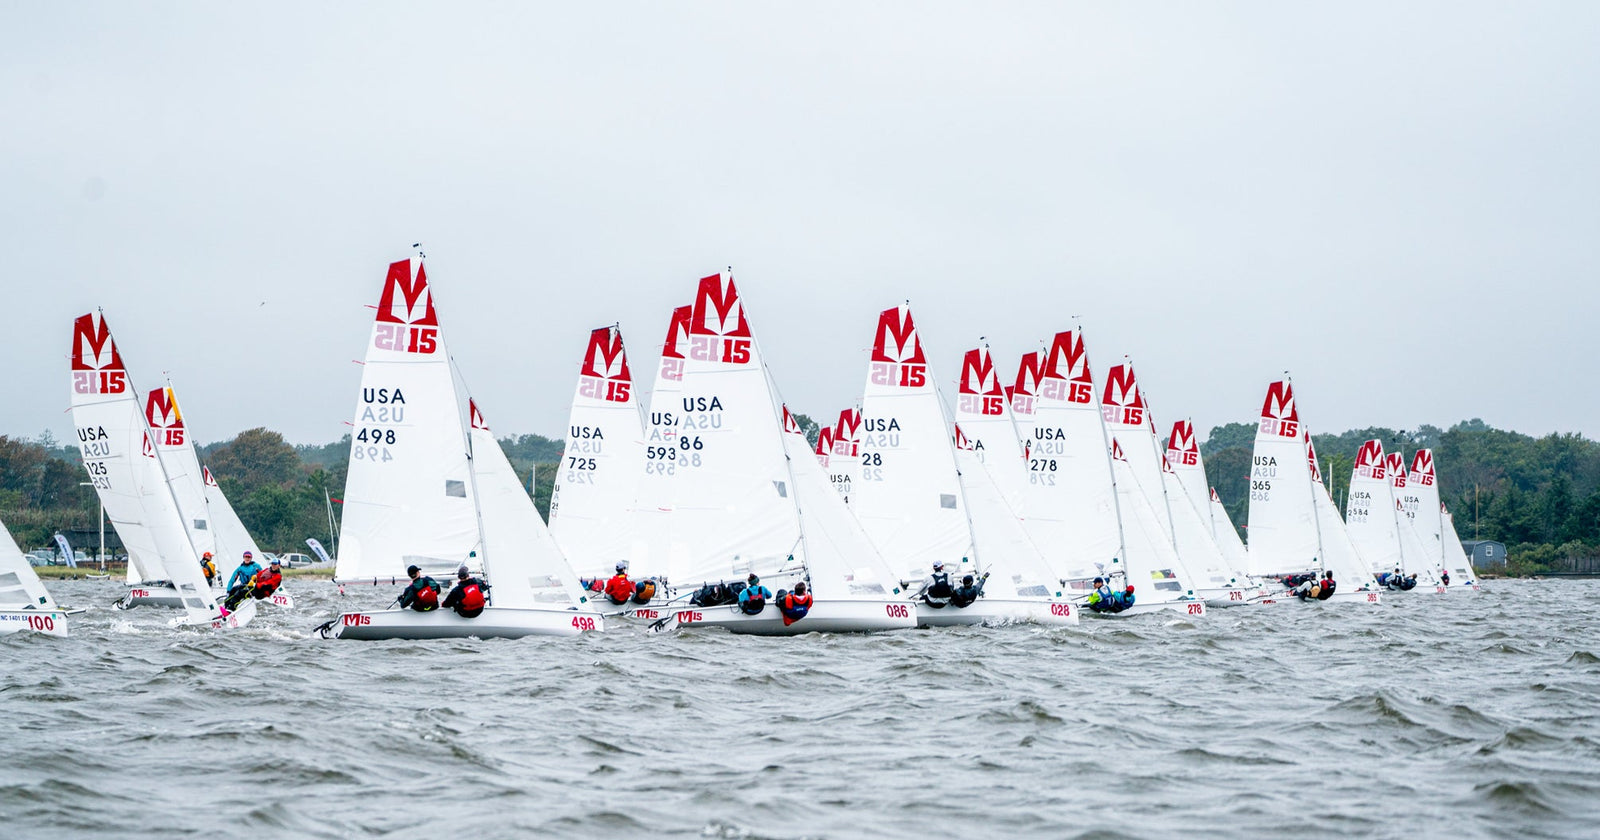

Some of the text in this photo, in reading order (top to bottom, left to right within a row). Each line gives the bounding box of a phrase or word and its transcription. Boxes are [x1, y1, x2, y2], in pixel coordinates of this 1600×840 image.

[407, 327, 437, 354] 15
[722, 339, 751, 364] 15
[99, 371, 125, 394] 15
[899, 365, 926, 387] 15
[364, 388, 406, 404] USA
[606, 381, 631, 402] 15
[1068, 382, 1092, 404] 15
[683, 396, 723, 412] USA
[982, 397, 1003, 415] 15
[1123, 408, 1143, 425] 15
[864, 418, 900, 432] USA
[1279, 421, 1298, 438] 15
[77, 426, 108, 442] USA
[165, 430, 184, 445] 15
[357, 428, 396, 444] 498
[571, 426, 604, 440] USA
[1035, 428, 1066, 440] USA
[680, 436, 703, 450] 86
[647, 446, 676, 460] 593
[862, 453, 882, 466] 28
[1182, 452, 1198, 465] 15
[568, 456, 597, 470] 725
[1031, 459, 1058, 471] 278
[1254, 456, 1277, 466] USA
[86, 462, 107, 475] 125
[1372, 468, 1385, 480] 15
[830, 474, 851, 483] USA
[1252, 480, 1271, 490] 365
[1394, 478, 1406, 488] 15
[1421, 475, 1434, 486] 15
[1354, 491, 1371, 499] USA
[273, 595, 288, 605] 272
[1229, 592, 1243, 600] 276
[886, 604, 909, 618] 086
[1051, 603, 1070, 616] 028
[1187, 604, 1202, 615] 278
[28, 615, 54, 631] 100
[571, 616, 596, 630] 498
